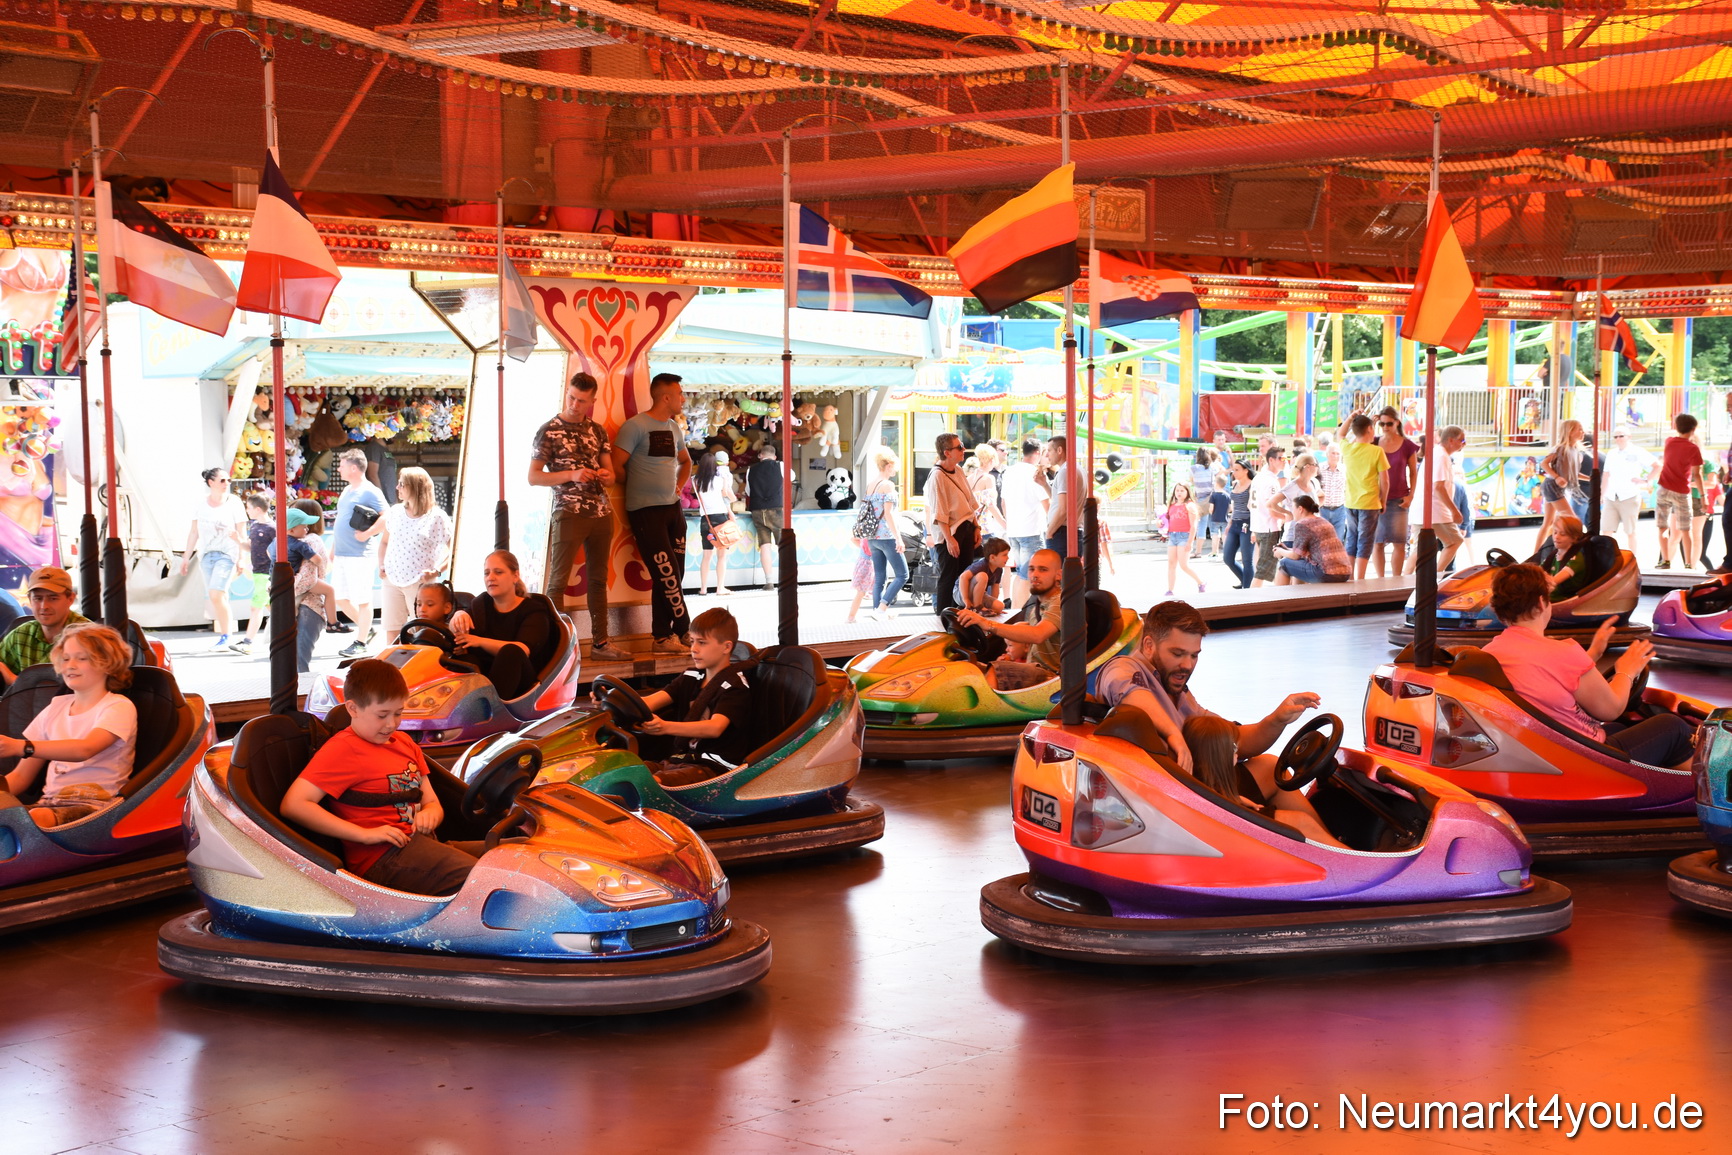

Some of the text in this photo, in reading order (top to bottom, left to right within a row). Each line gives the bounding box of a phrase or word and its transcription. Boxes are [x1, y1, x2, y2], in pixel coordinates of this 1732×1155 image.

[1110, 475, 1137, 497] EINGANG
[653, 550, 685, 618] adidas
[1391, 726, 1415, 744] 02
[1034, 796, 1056, 818] 04
